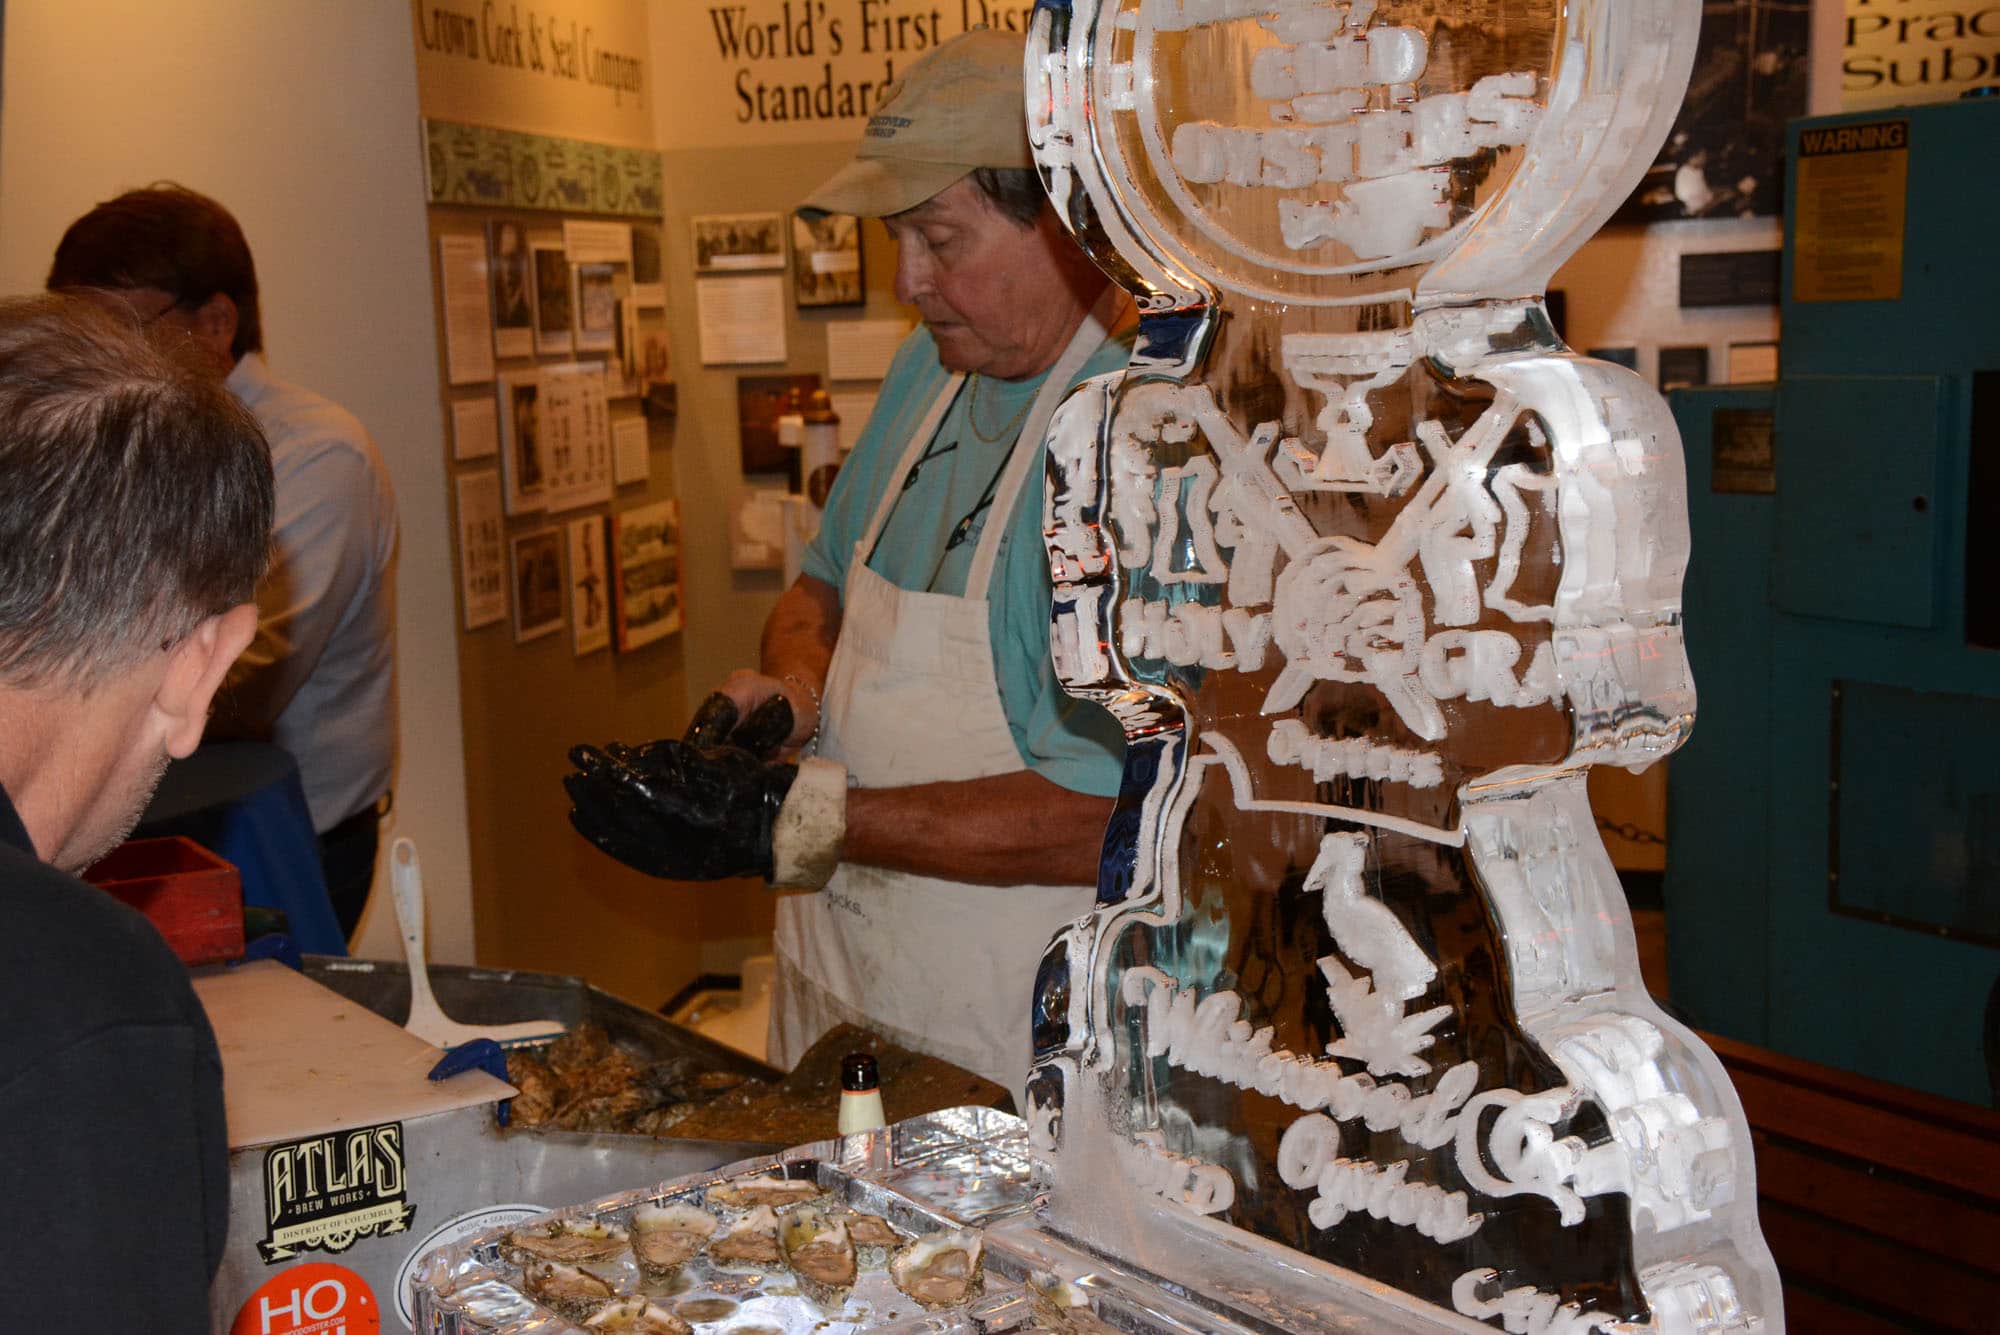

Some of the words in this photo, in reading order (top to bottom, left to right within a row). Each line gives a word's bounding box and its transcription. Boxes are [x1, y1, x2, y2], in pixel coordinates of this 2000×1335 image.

[709, 0, 844, 61] World's
[860, 0, 941, 53] First
[1841, 47, 2000, 91] Sub
[1803, 124, 1904, 153] WARNING
[269, 1125, 404, 1225] ATLAS
[282, 1223, 328, 1241] DISTRICT
[329, 1219, 341, 1229] OF
[343, 1207, 394, 1226] COLUMBIA
[295, 1199, 324, 1215] BREW
[330, 1190, 365, 1207] WORKS
[260, 1279, 347, 1335] HO
